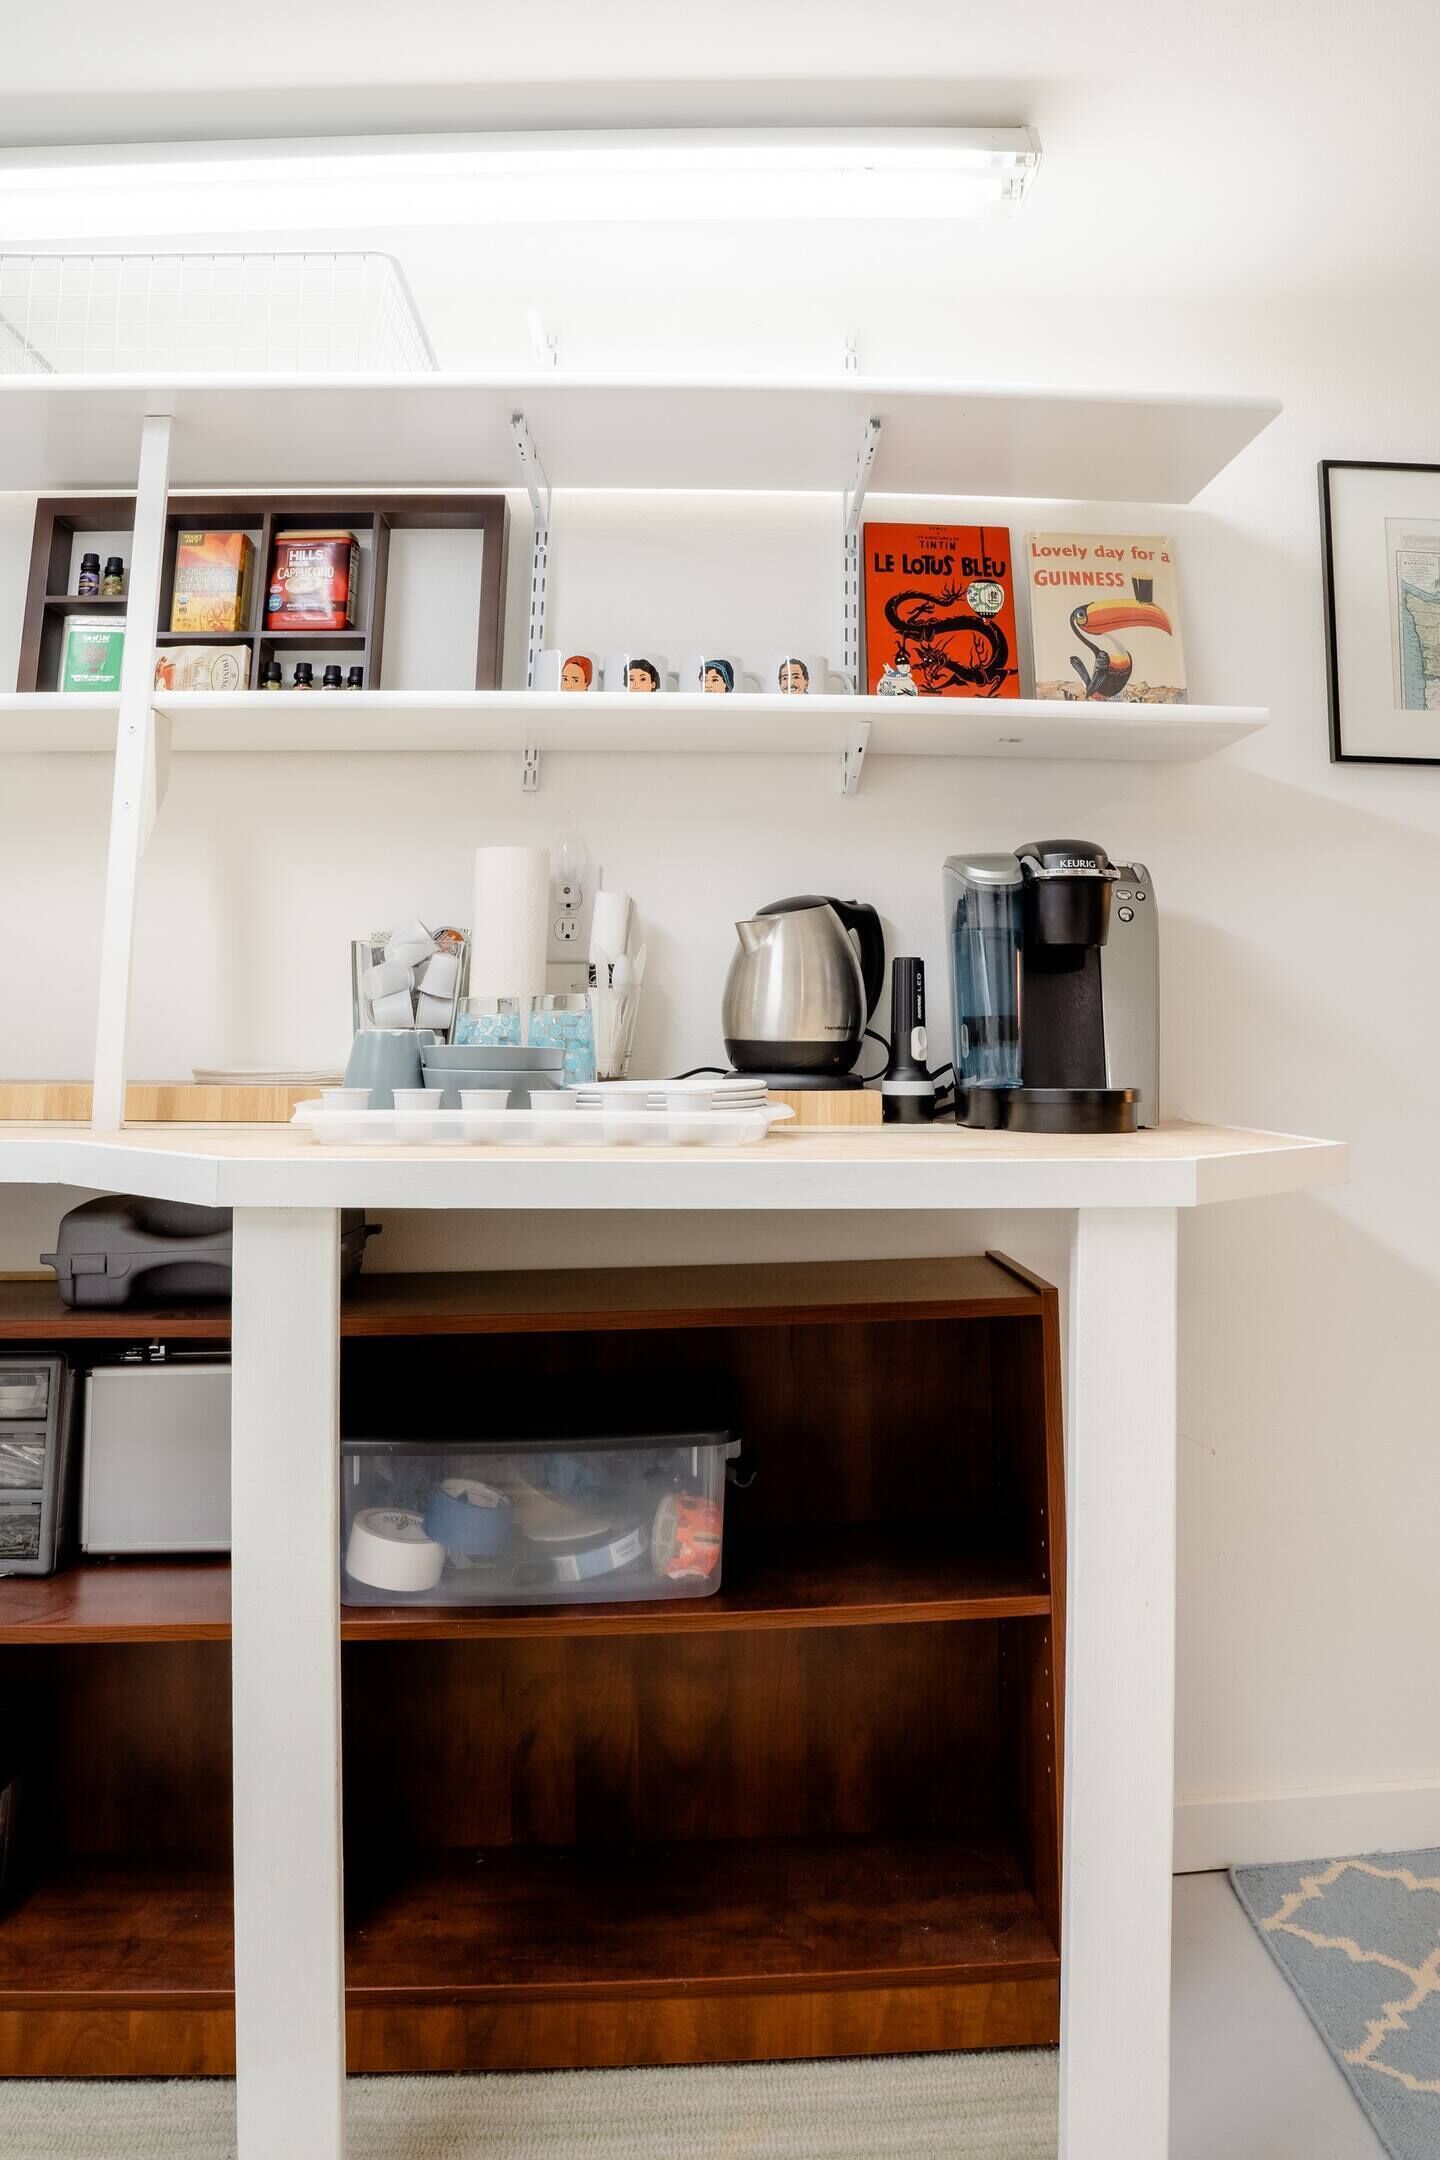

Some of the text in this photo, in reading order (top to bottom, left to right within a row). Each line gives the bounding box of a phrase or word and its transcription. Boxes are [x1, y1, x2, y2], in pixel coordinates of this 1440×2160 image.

[919, 540, 957, 550] TINTIN
[1031, 543, 1171, 563] Lovely day for a
[289, 549, 325, 561] HILLS
[277, 566, 335, 580] CAPPUCCINO
[874, 552, 1006, 578] LE LOTUS BLEU
[1033, 569, 1125, 587] GUINNESS
[220, 658, 230, 690] TWINING
[1060, 859, 1096, 868] KEURIG
